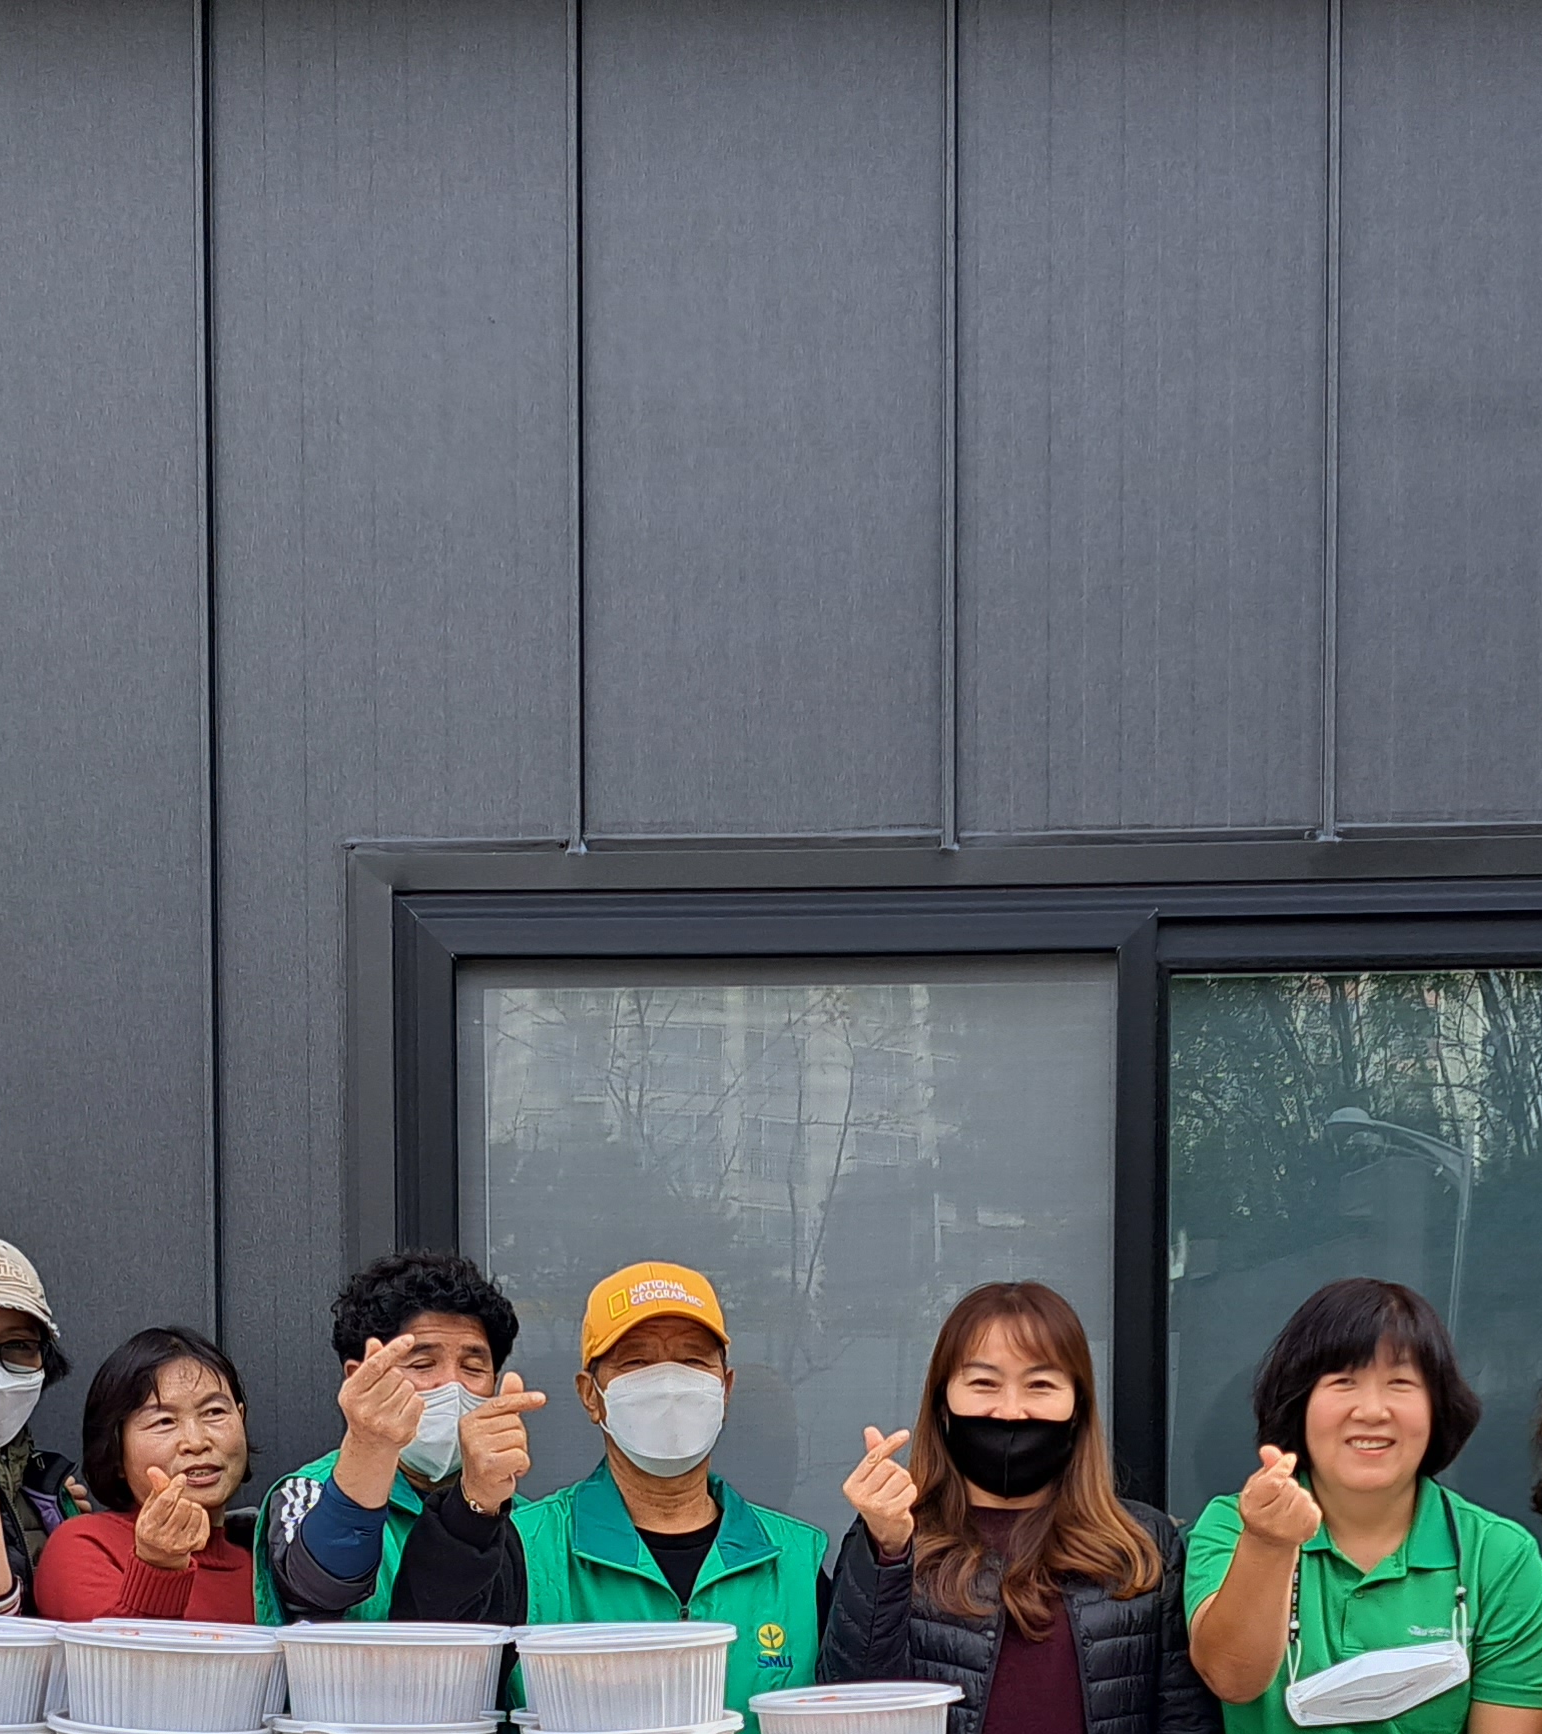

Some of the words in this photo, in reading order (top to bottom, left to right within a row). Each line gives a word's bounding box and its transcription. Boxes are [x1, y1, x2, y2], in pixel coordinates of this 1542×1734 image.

[629, 1279, 687, 1296] NATIONAL
[630, 1289, 704, 1308] GEOGRAPHIC
[757, 1655, 793, 1668] SMU
